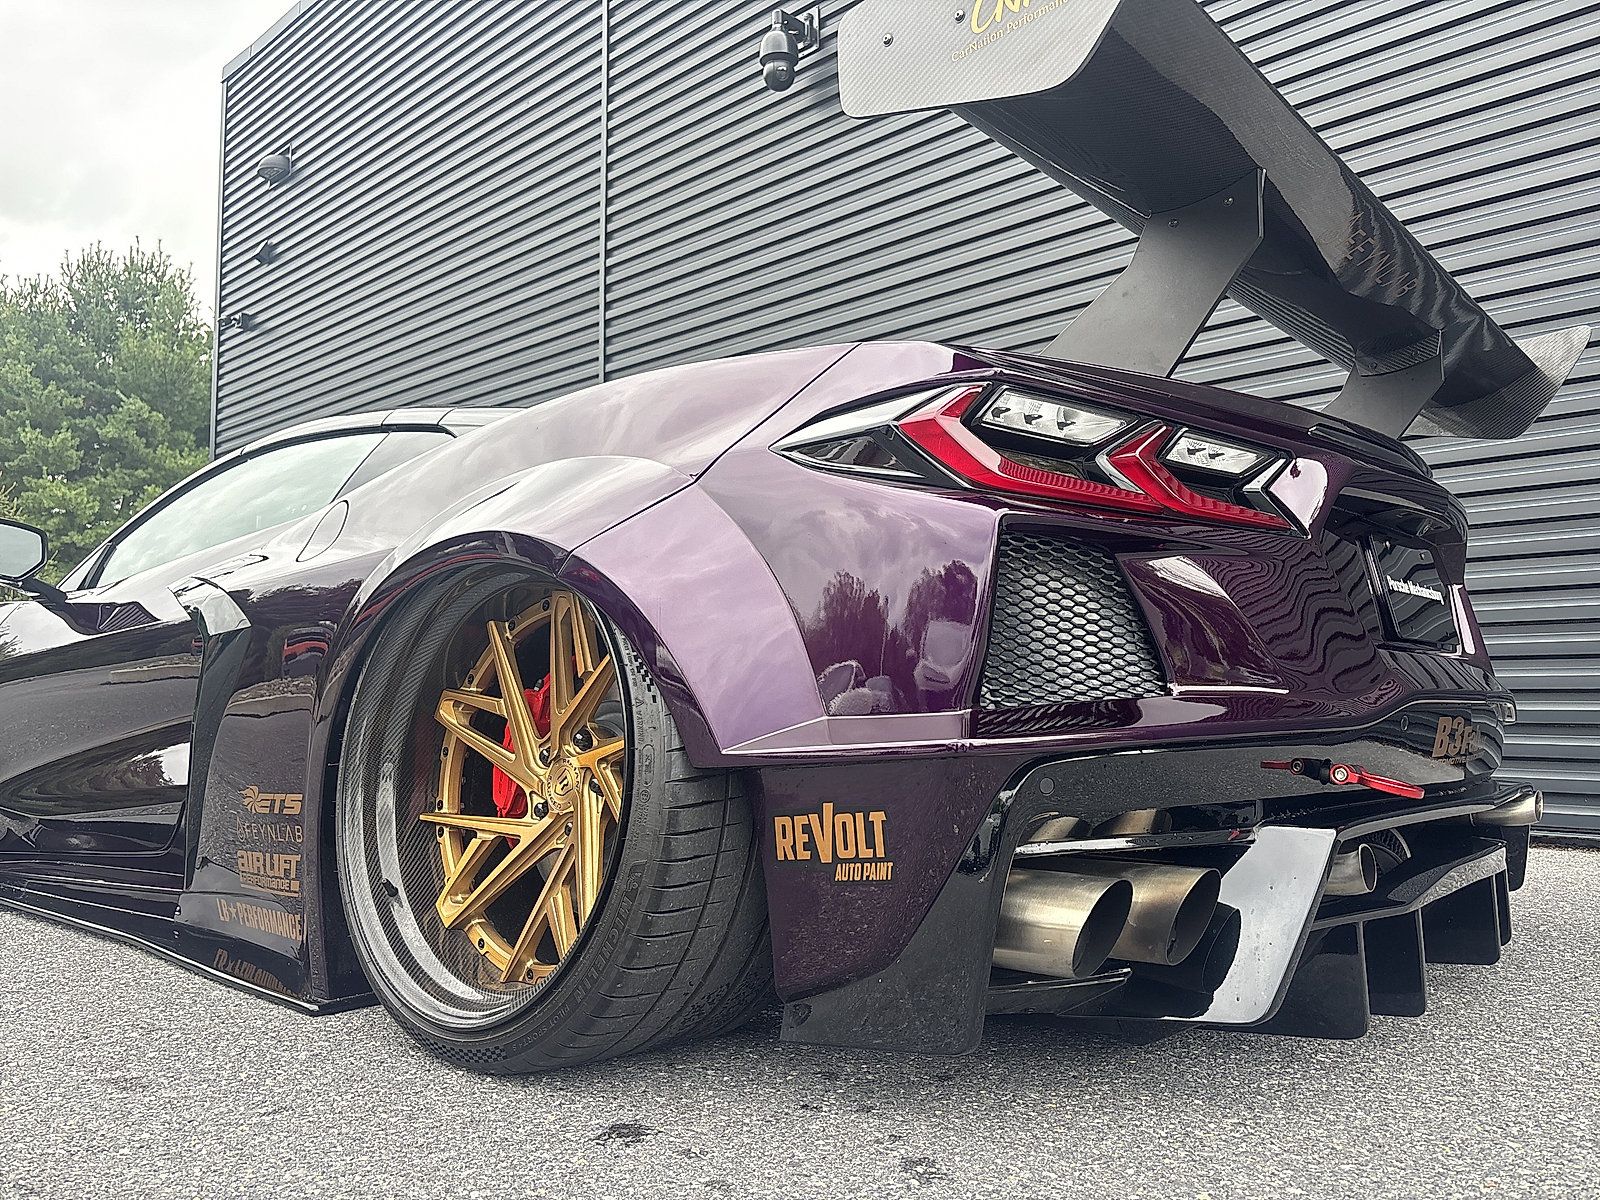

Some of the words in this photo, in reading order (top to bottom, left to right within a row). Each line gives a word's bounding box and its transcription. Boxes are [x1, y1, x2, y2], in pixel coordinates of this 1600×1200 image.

[951, 28, 1005, 62] CarNation
[254, 793, 303, 815] ETS
[774, 802, 887, 863] REVOLT
[265, 852, 301, 879] LIFT
[834, 863, 862, 881] AUTO
[862, 862, 893, 881] PAINT
[573, 896, 634, 1003] MICHELIN
[549, 1004, 571, 1028] PILOT
[522, 1025, 548, 1047] SPORT
